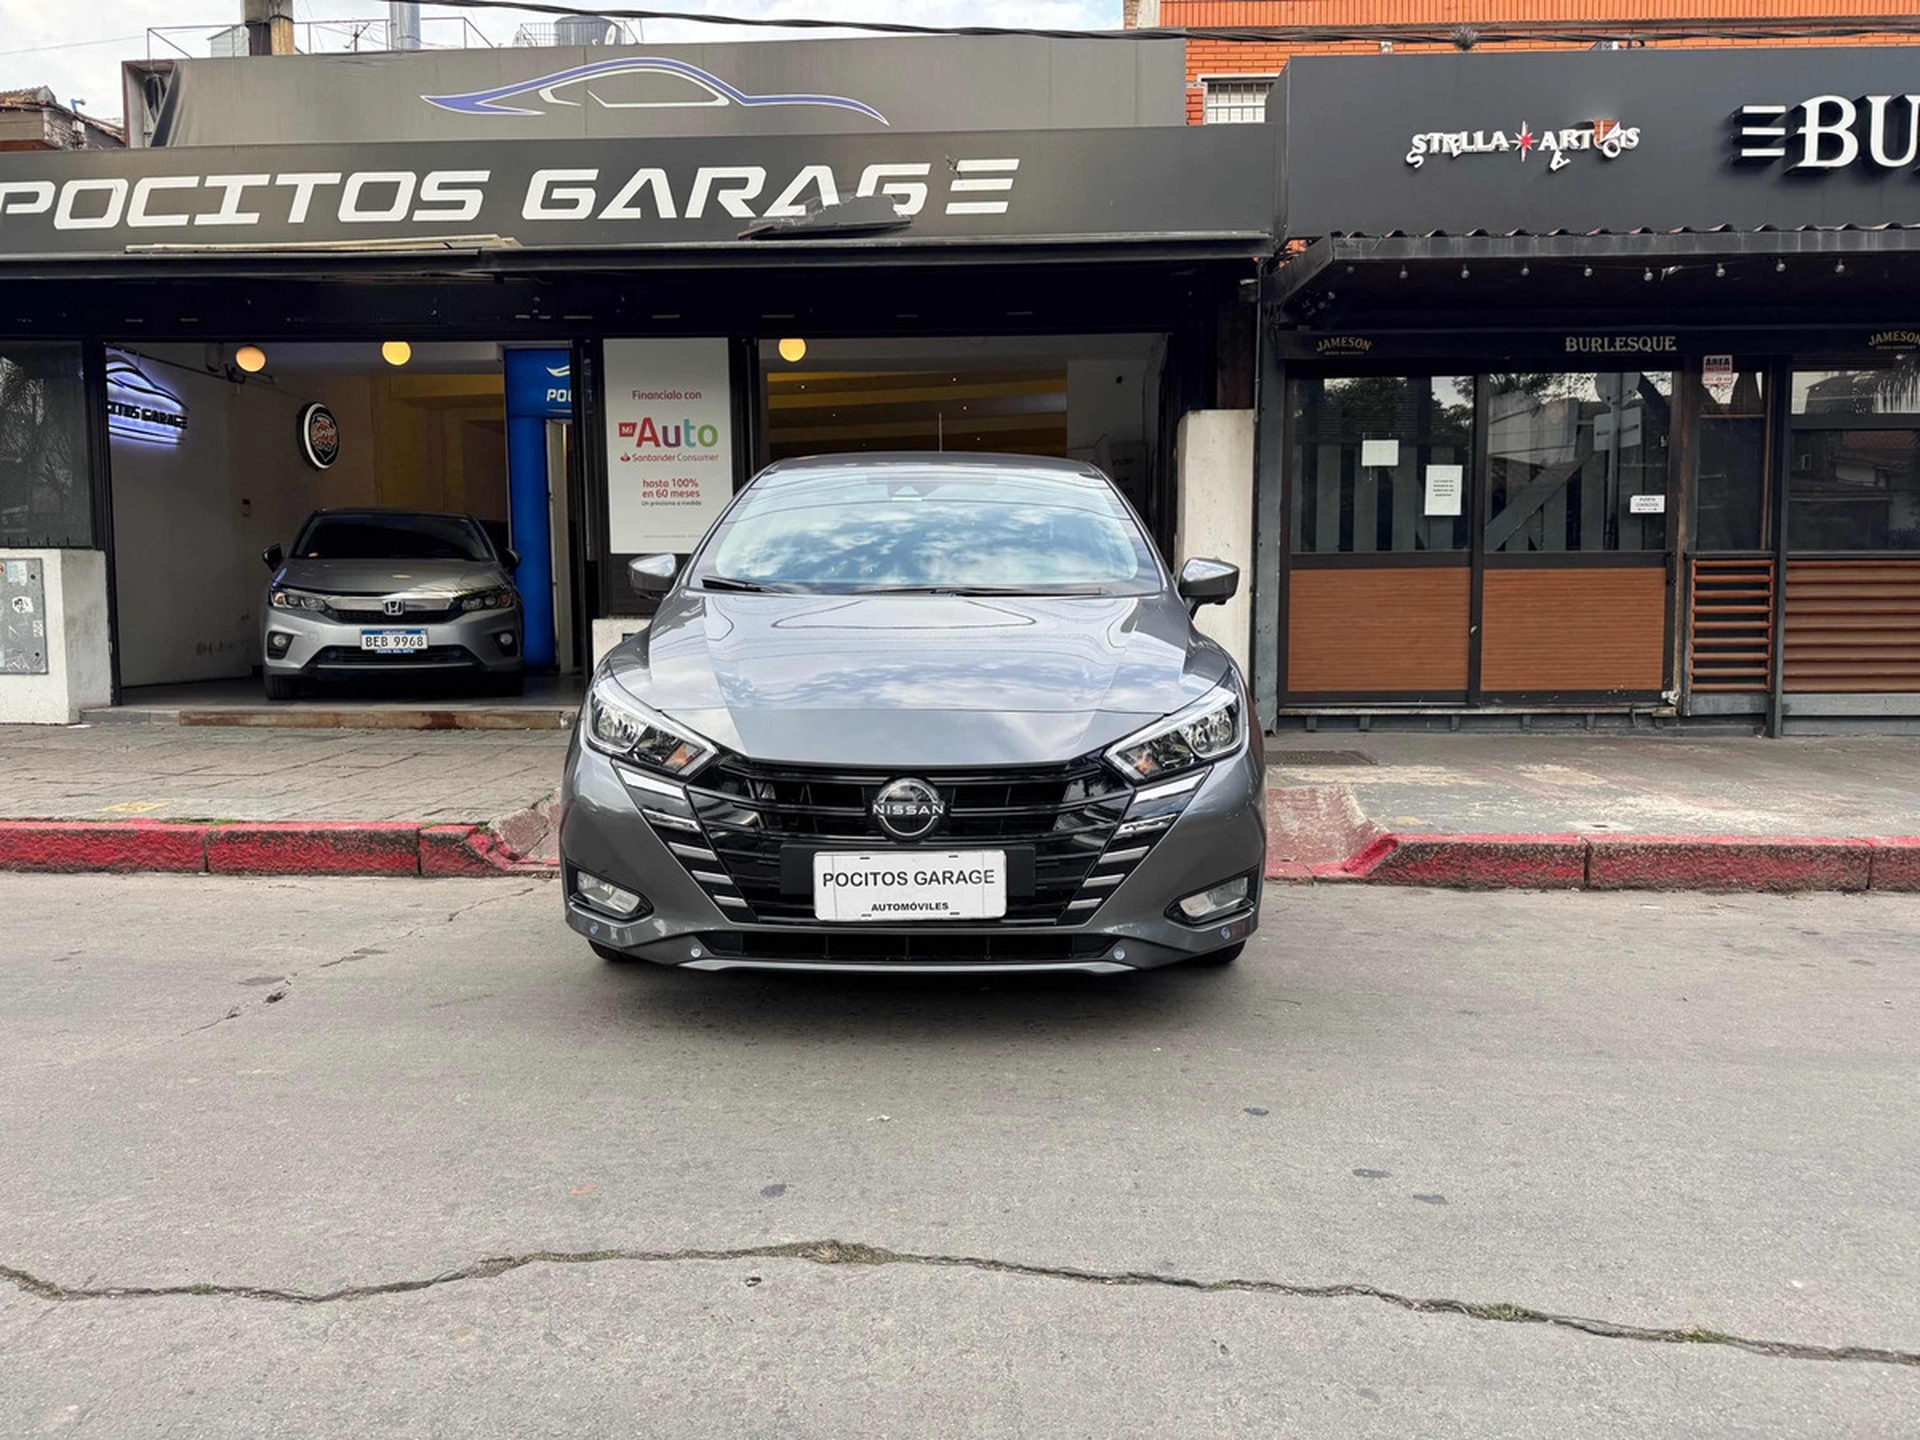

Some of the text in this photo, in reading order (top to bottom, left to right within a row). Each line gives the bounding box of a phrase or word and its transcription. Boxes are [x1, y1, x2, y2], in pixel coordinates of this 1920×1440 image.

[1407, 130, 1510, 165] STELLA
[0, 158, 1020, 230] POCITOS GARAGE
[1316, 335, 1372, 352] JAMESON
[1564, 336, 1678, 351] BURLESQUE
[684, 391, 702, 400] con
[141, 407, 188, 430] GARAGE
[636, 416, 719, 448] Auto
[632, 452, 719, 462] Santander Consumer
[642, 478, 699, 488] hasta 100%
[642, 489, 701, 498] en 60 meses
[365, 636, 424, 648] BEB 9968
[872, 803, 944, 816] NISSAN
[822, 869, 996, 888] POCITOS GARAGE
[870, 902, 949, 912] AUTOMÓVILES
